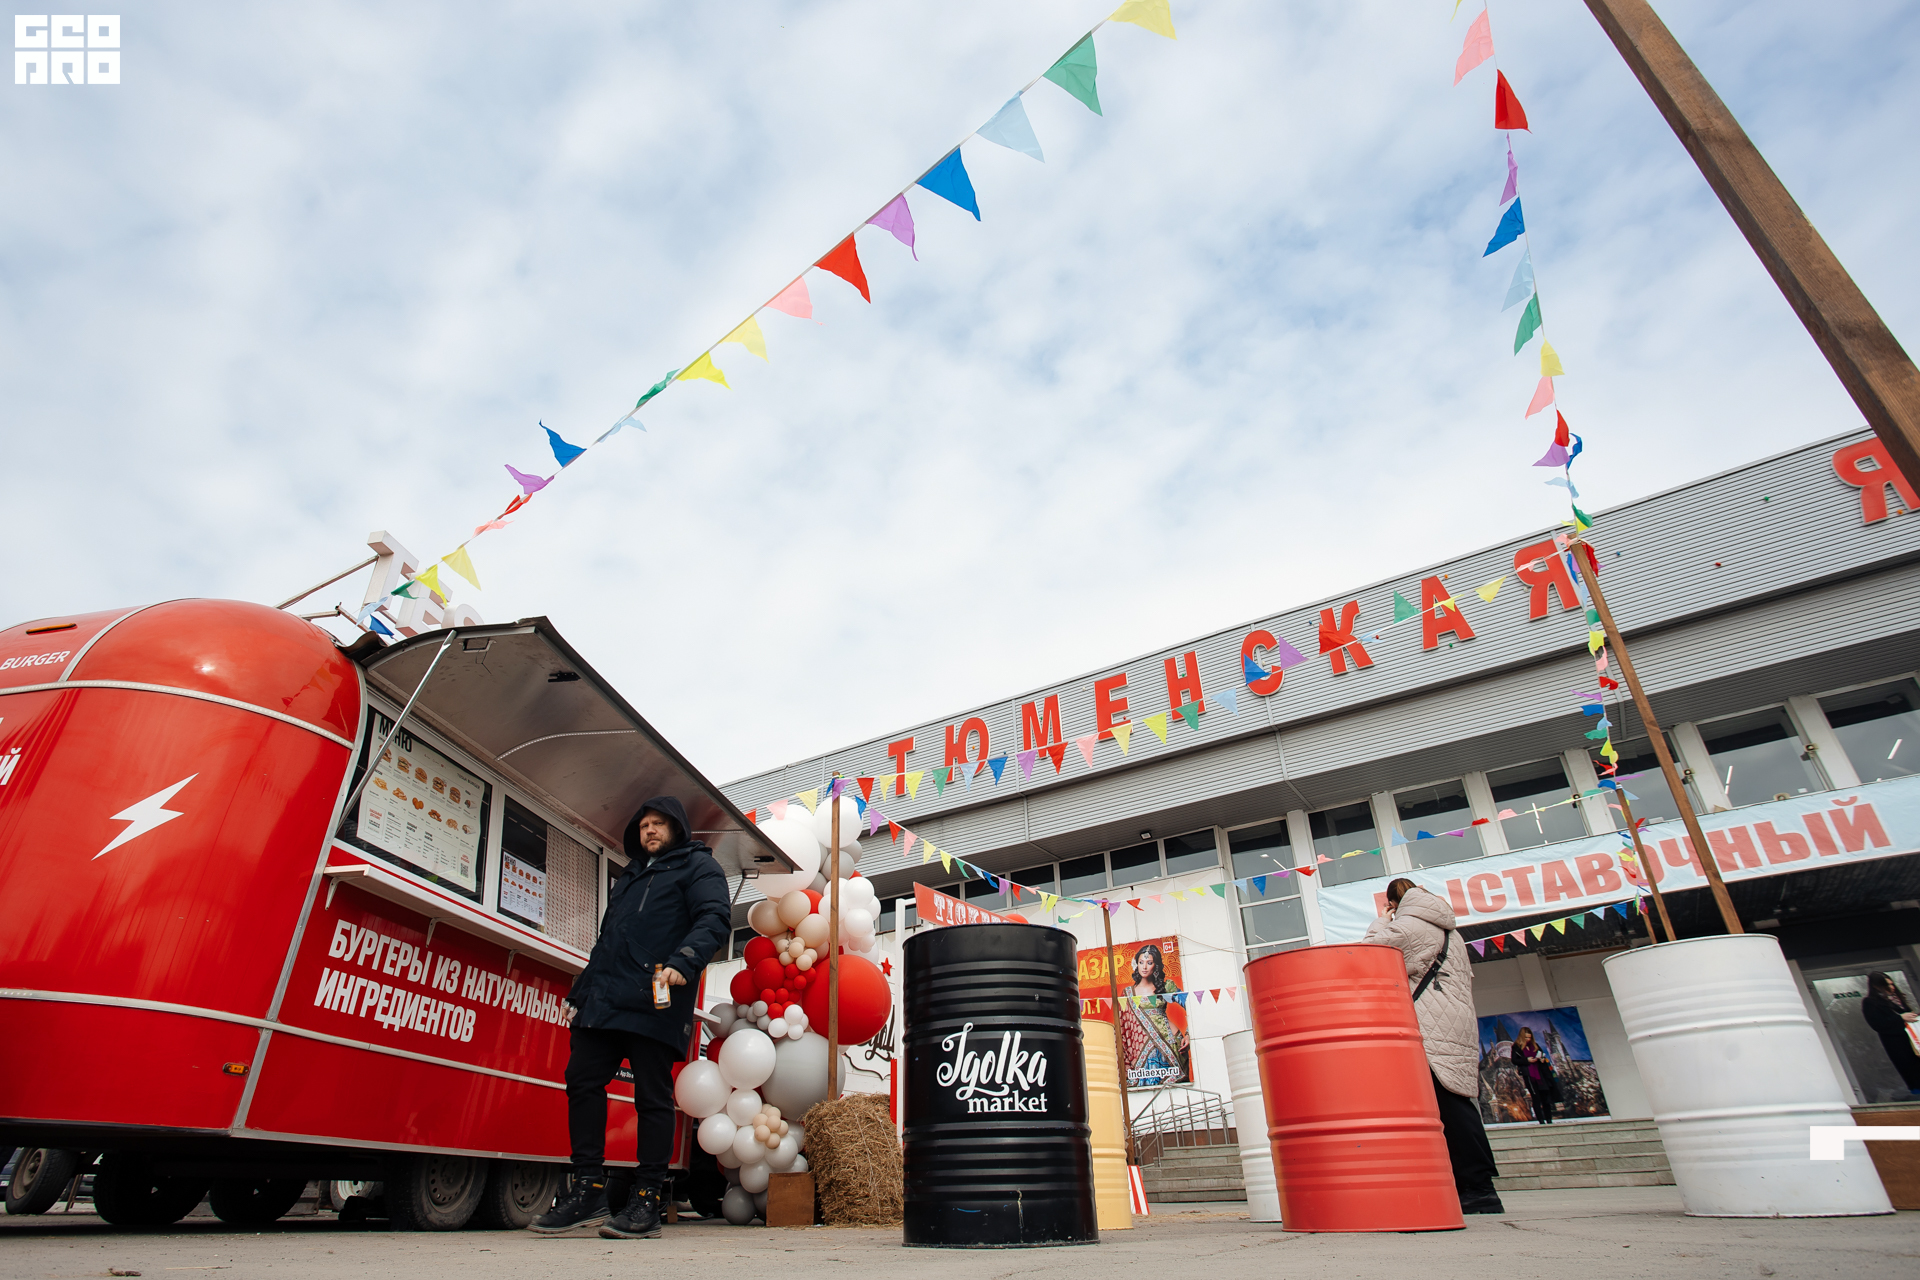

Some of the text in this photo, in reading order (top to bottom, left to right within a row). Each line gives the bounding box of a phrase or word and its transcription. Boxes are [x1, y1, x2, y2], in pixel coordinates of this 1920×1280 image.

[0, 651, 70, 670] BURGER
[887, 538, 1584, 798] ТЮМЕНСКАЯ
[379, 717, 412, 753] МНЮ
[328, 918, 433, 986] БУРГЕРЫ
[431, 955, 462, 994] ИЗ
[1078, 954, 1125, 981] АЗАР
[313, 966, 477, 1043] ИНГРЕДИЕНТОВ
[1127, 1066, 1179, 1079] indiaexp.ru
[967, 1092, 1048, 1114] market
